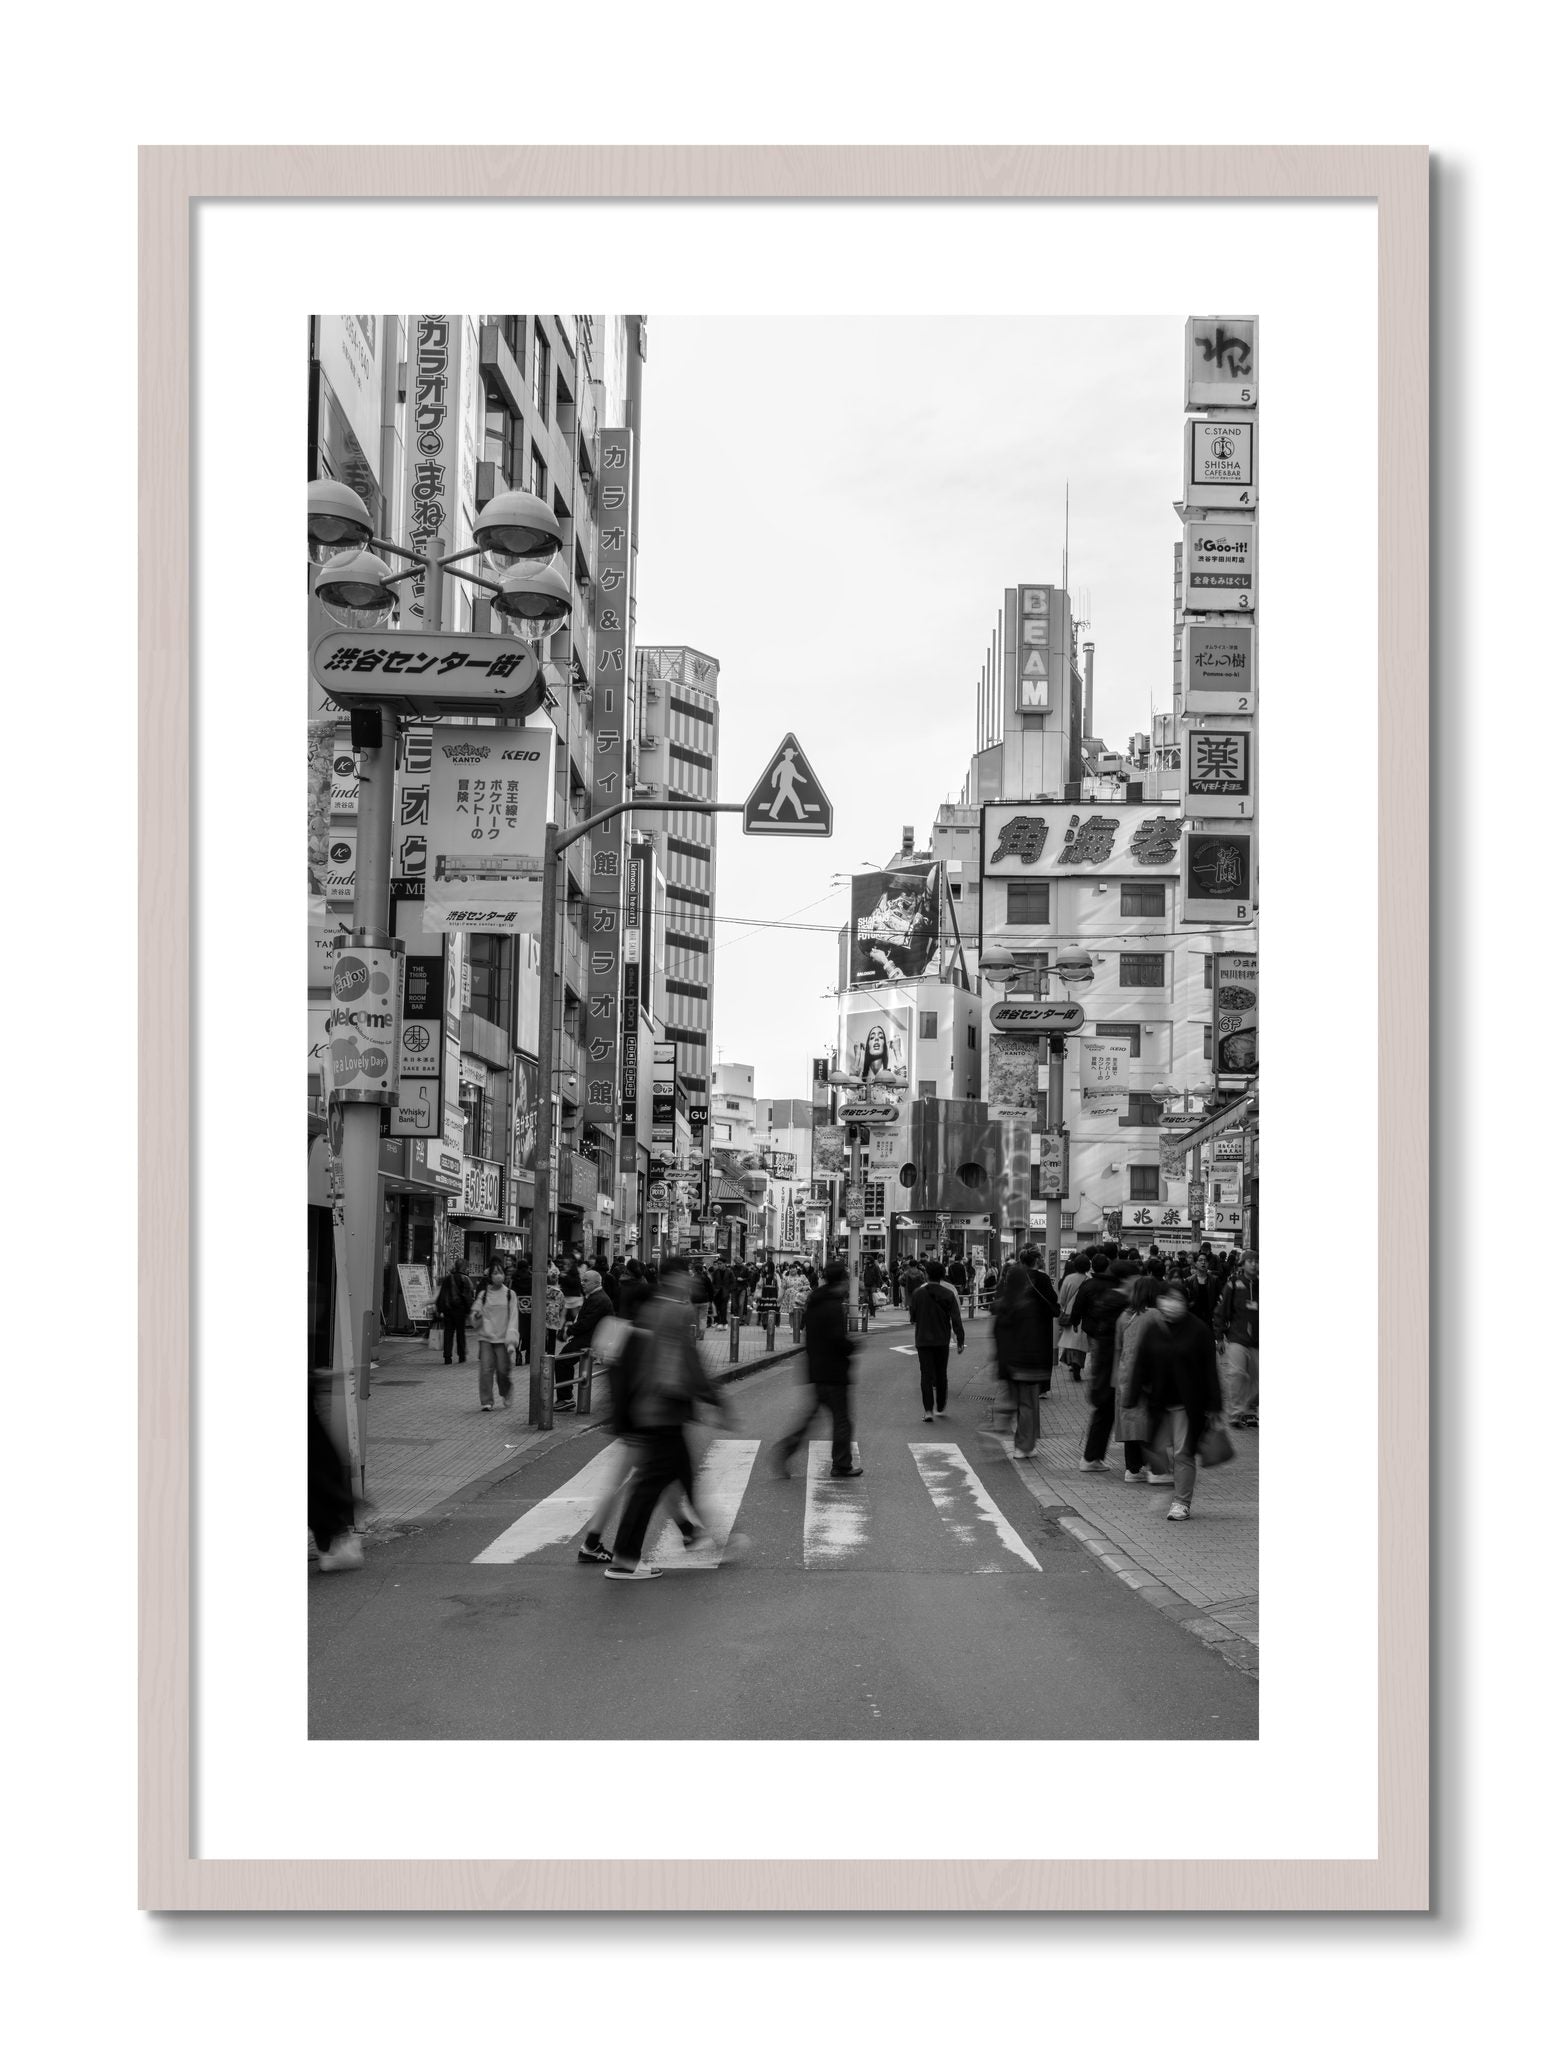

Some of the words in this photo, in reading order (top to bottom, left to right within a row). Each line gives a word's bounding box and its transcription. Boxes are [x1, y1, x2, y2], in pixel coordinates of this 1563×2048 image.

[414, 320, 450, 432] カラオケ
[1241, 389, 1251, 402] 5
[1204, 428, 1242, 436] C.STAND
[1204, 460, 1241, 469] SHISHA
[1204, 469, 1241, 477] CAFE&BAR
[1240, 491, 1250, 504] 4
[1203, 539, 1248, 553] Goo-it!
[1193, 576, 1249, 586] 全身もみほぐし
[1238, 594, 1249, 608] 3
[1022, 589, 1049, 706] BEAM
[323, 647, 526, 679] 渋谷センター街
[1238, 697, 1248, 711] 2
[501, 750, 541, 762] KEIO
[1197, 737, 1239, 778] 薬
[1192, 781, 1242, 793] マツモトキヨシ
[456, 779, 470, 814] 冒険へ
[471, 779, 486, 839] カントーの
[487, 779, 504, 840] ポケパーク
[505, 780, 520, 829] 京王線で
[1238, 802, 1245, 814] 1
[989, 815, 1186, 865] 角海老
[1192, 846, 1242, 886] 一蘭
[629, 863, 637, 892] kimono
[445, 911, 518, 922] 渋谷センター街
[628, 895, 637, 924] hearts
[1236, 905, 1246, 919] B
[334, 967, 367, 995] Enjoy
[330, 1007, 393, 1029] Welcome
[995, 1009, 1079, 1020] 渋谷センター街
[1218, 1016, 1242, 1032] 6F
[344, 1055, 369, 1071] Lovely
[370, 1055, 387, 1067] Day!
[398, 1115, 415, 1123] Bank
[399, 1107, 427, 1117] Whisky
[690, 1111, 707, 1120] GU
[380, 1124, 389, 1134] 1F
[786, 1206, 794, 1241] BEER
